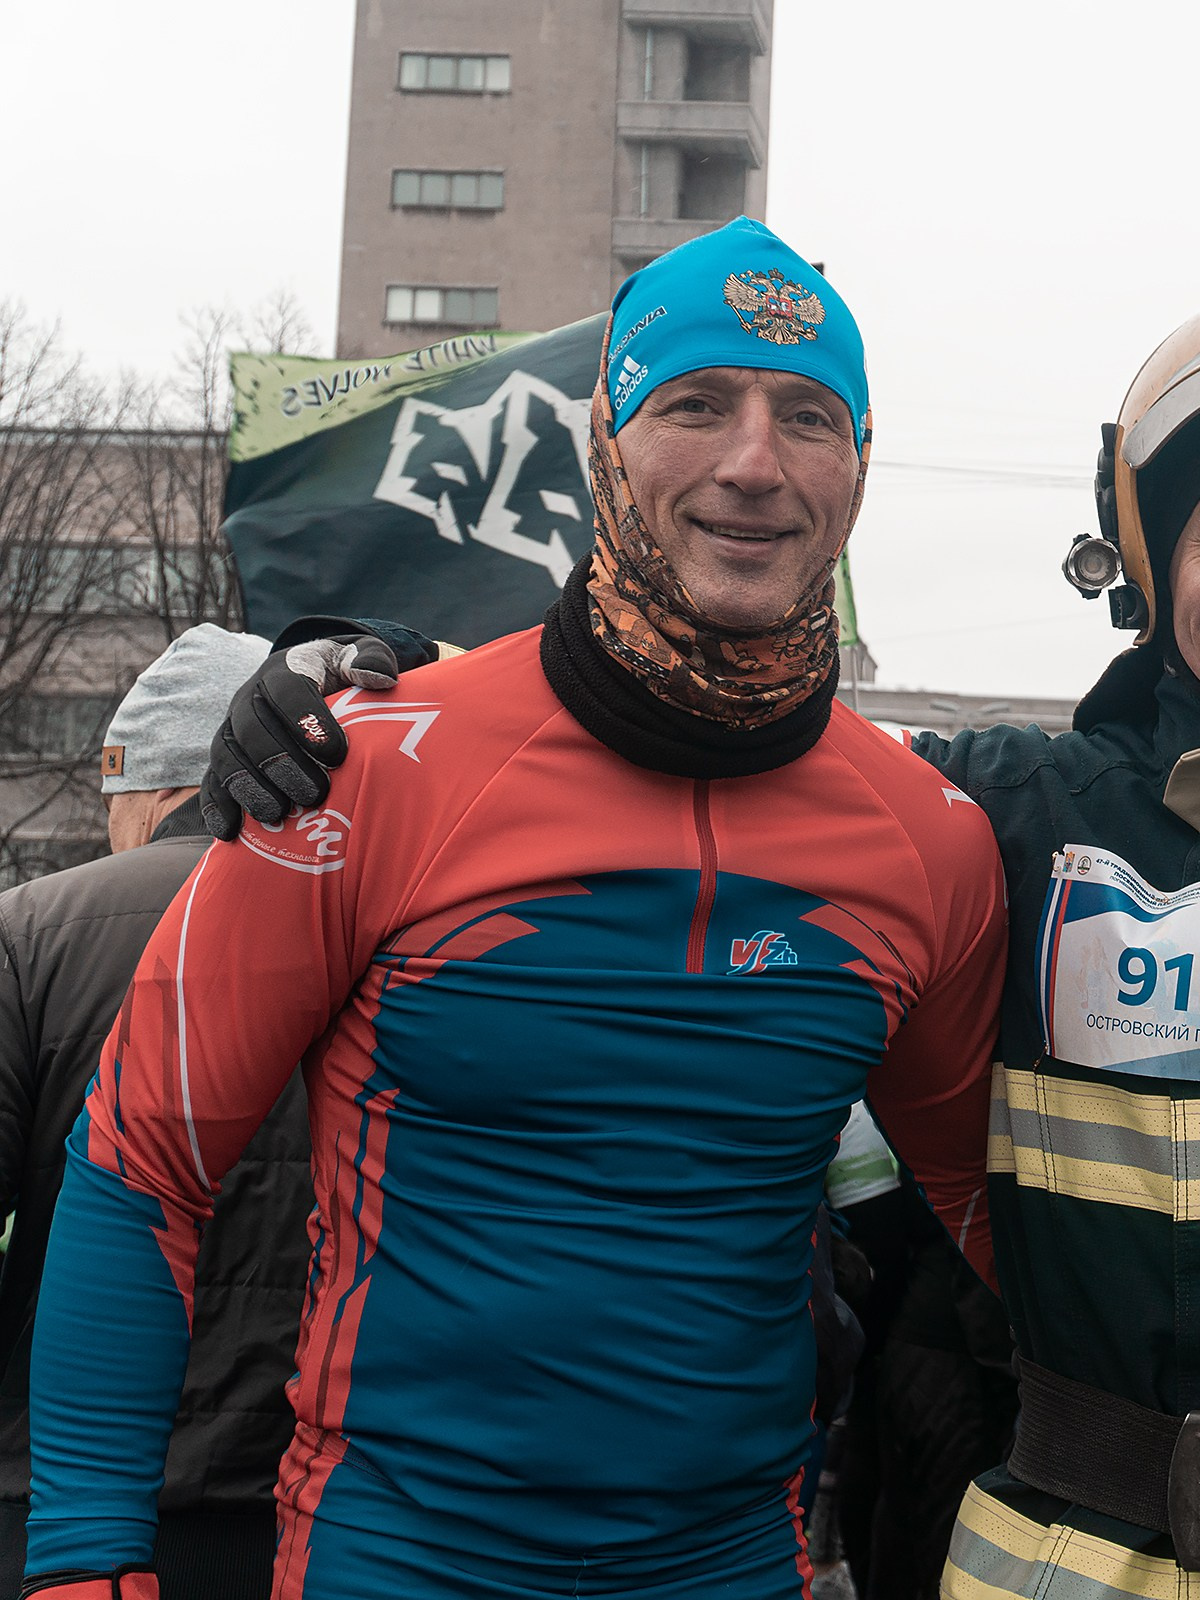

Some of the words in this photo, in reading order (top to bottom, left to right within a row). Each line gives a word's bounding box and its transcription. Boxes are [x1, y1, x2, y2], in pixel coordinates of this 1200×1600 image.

[614, 364, 648, 411] adidas
[1117, 946, 1194, 1012] 91
[1086, 1013, 1190, 1041] ОСТРОВСКИЙ
